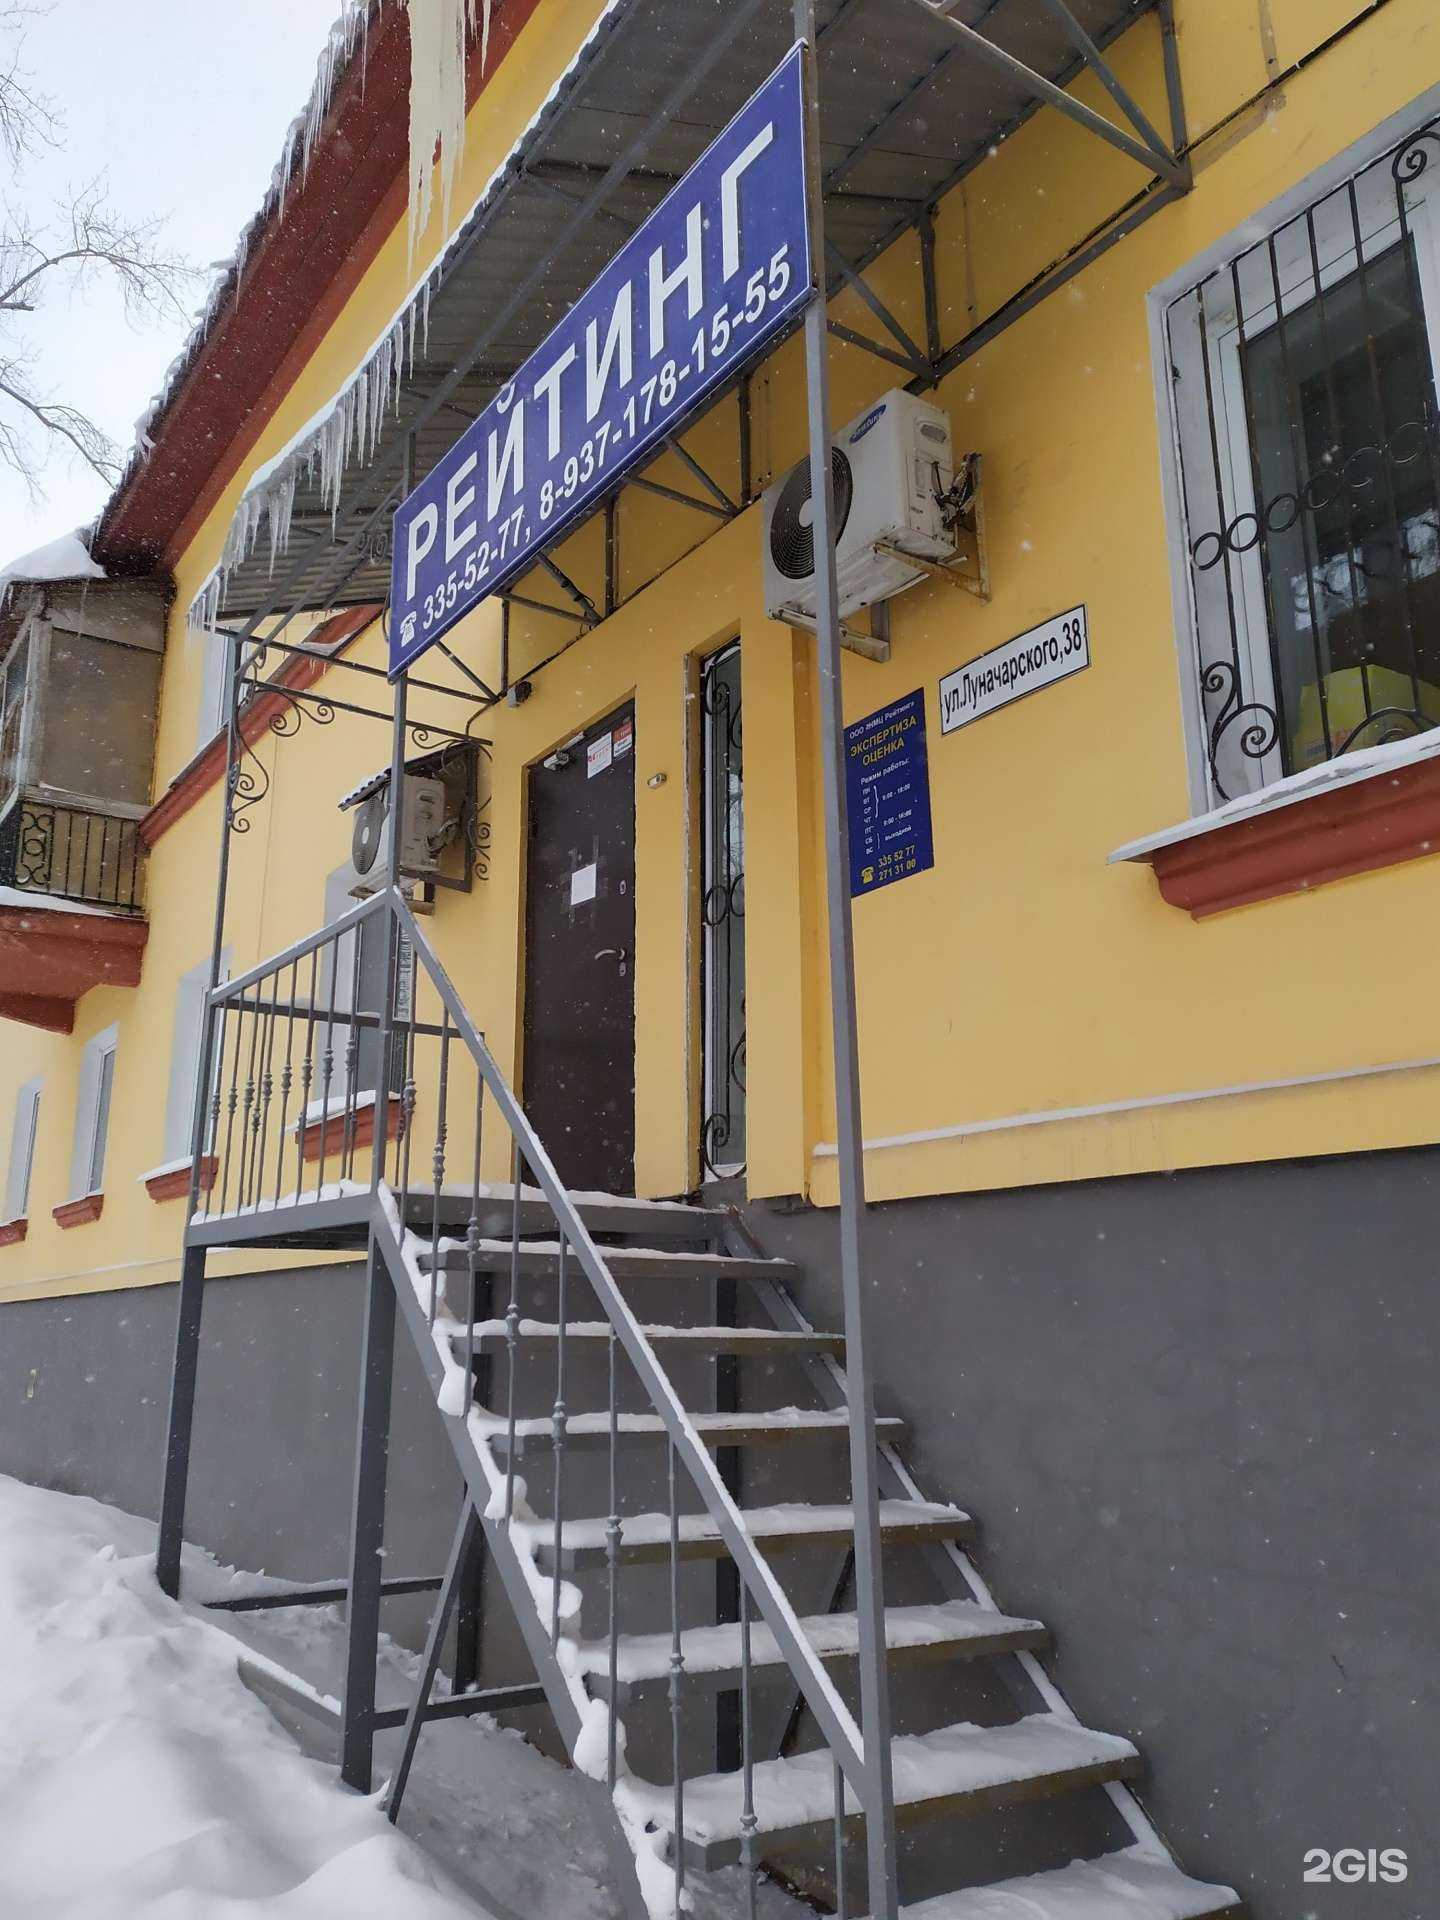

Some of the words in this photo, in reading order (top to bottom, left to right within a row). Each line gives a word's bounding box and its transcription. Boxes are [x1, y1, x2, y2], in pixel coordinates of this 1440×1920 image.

[406, 121, 774, 602] РЕЙТИНГ
[422, 506, 531, 630] 335-52-77,
[539, 243, 791, 521] 8-937-178-15-55
[849, 726, 865, 740] ООО
[850, 715, 917, 757] ЭКСПЕРТИЗА
[862, 737, 905, 766] ОЦЕНКА
[878, 854, 892, 867] 335
[893, 849, 904, 861] 52
[905, 845, 915, 856] 77
